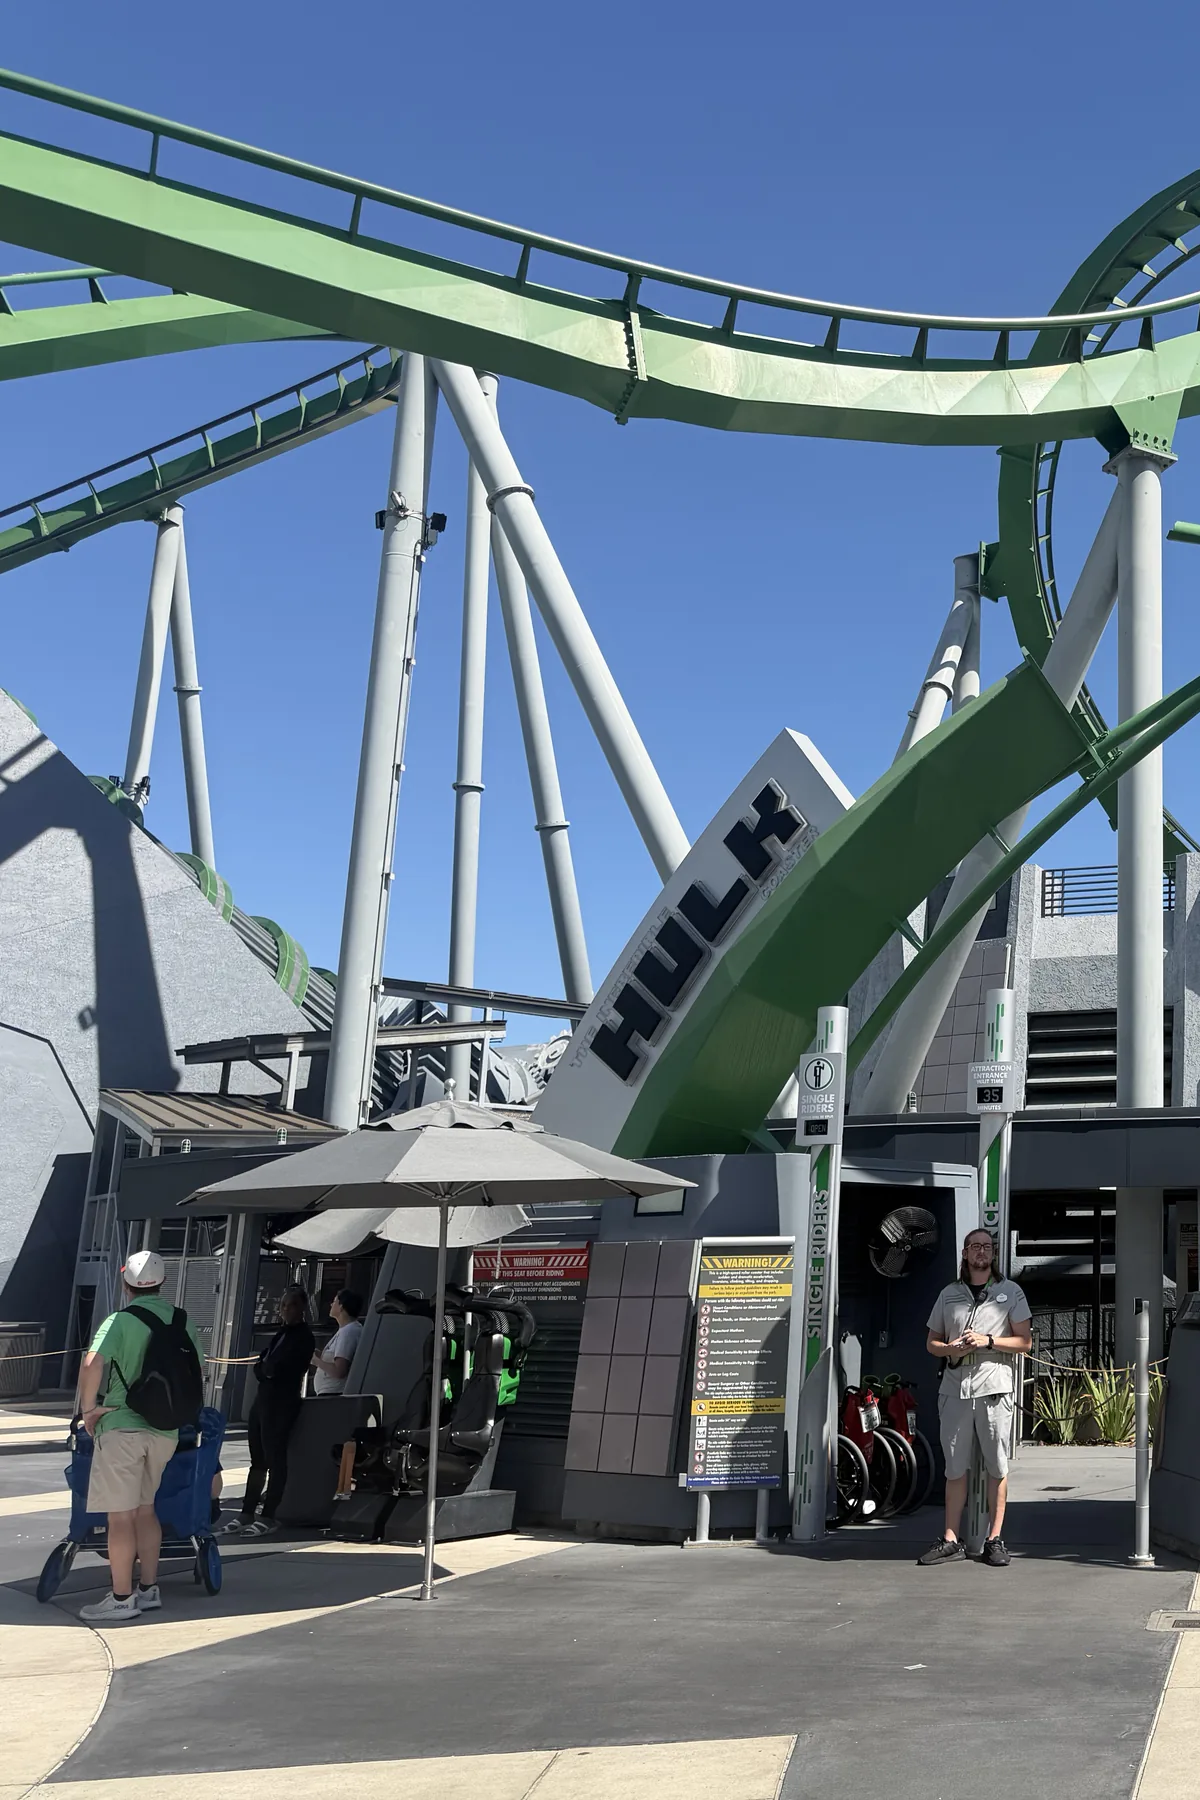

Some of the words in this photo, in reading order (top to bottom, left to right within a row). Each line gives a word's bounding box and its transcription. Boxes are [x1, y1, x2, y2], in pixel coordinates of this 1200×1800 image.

[760, 825, 820, 900] COASTER
[589, 778, 808, 1086] HULK
[801, 1094, 835, 1104] SINGLE
[983, 1088, 1000, 1102] 35
[801, 1104, 834, 1114] RIDERS
[810, 1124, 826, 1132] OPEN
[812, 1190, 829, 1256] RIDERS
[513, 1256, 544, 1266] WARNING!
[723, 1258, 772, 1268] WARNING!
[806, 1265, 824, 1339] SINGLE
